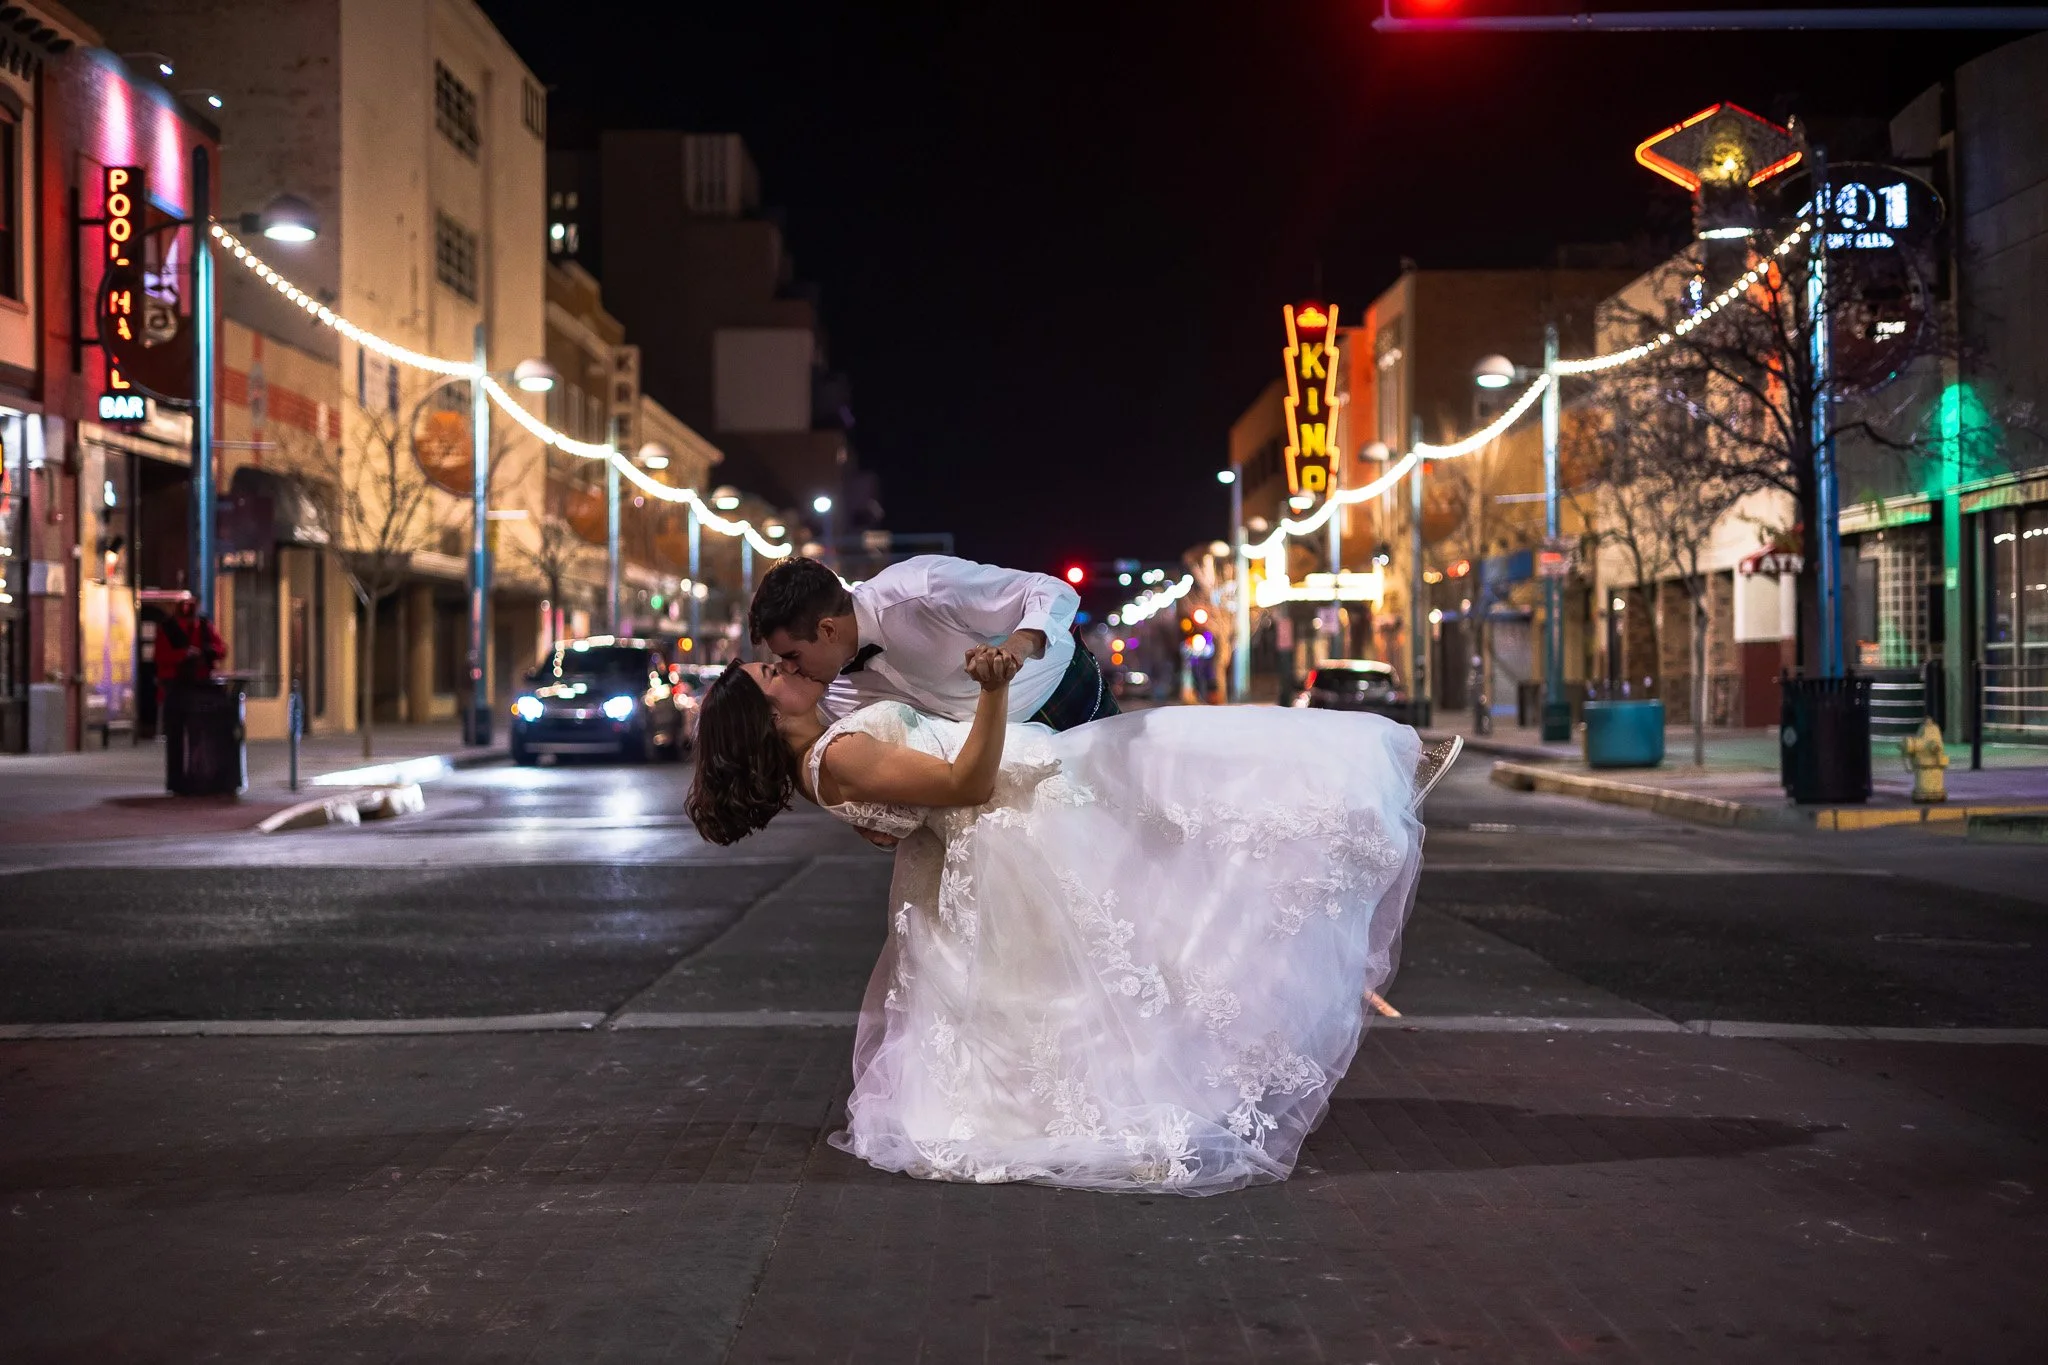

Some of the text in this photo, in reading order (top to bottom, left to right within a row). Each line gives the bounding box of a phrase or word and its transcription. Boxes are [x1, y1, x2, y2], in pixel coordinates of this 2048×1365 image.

[109, 169, 132, 389] POOL HAL
[99, 396, 144, 420] BAR
